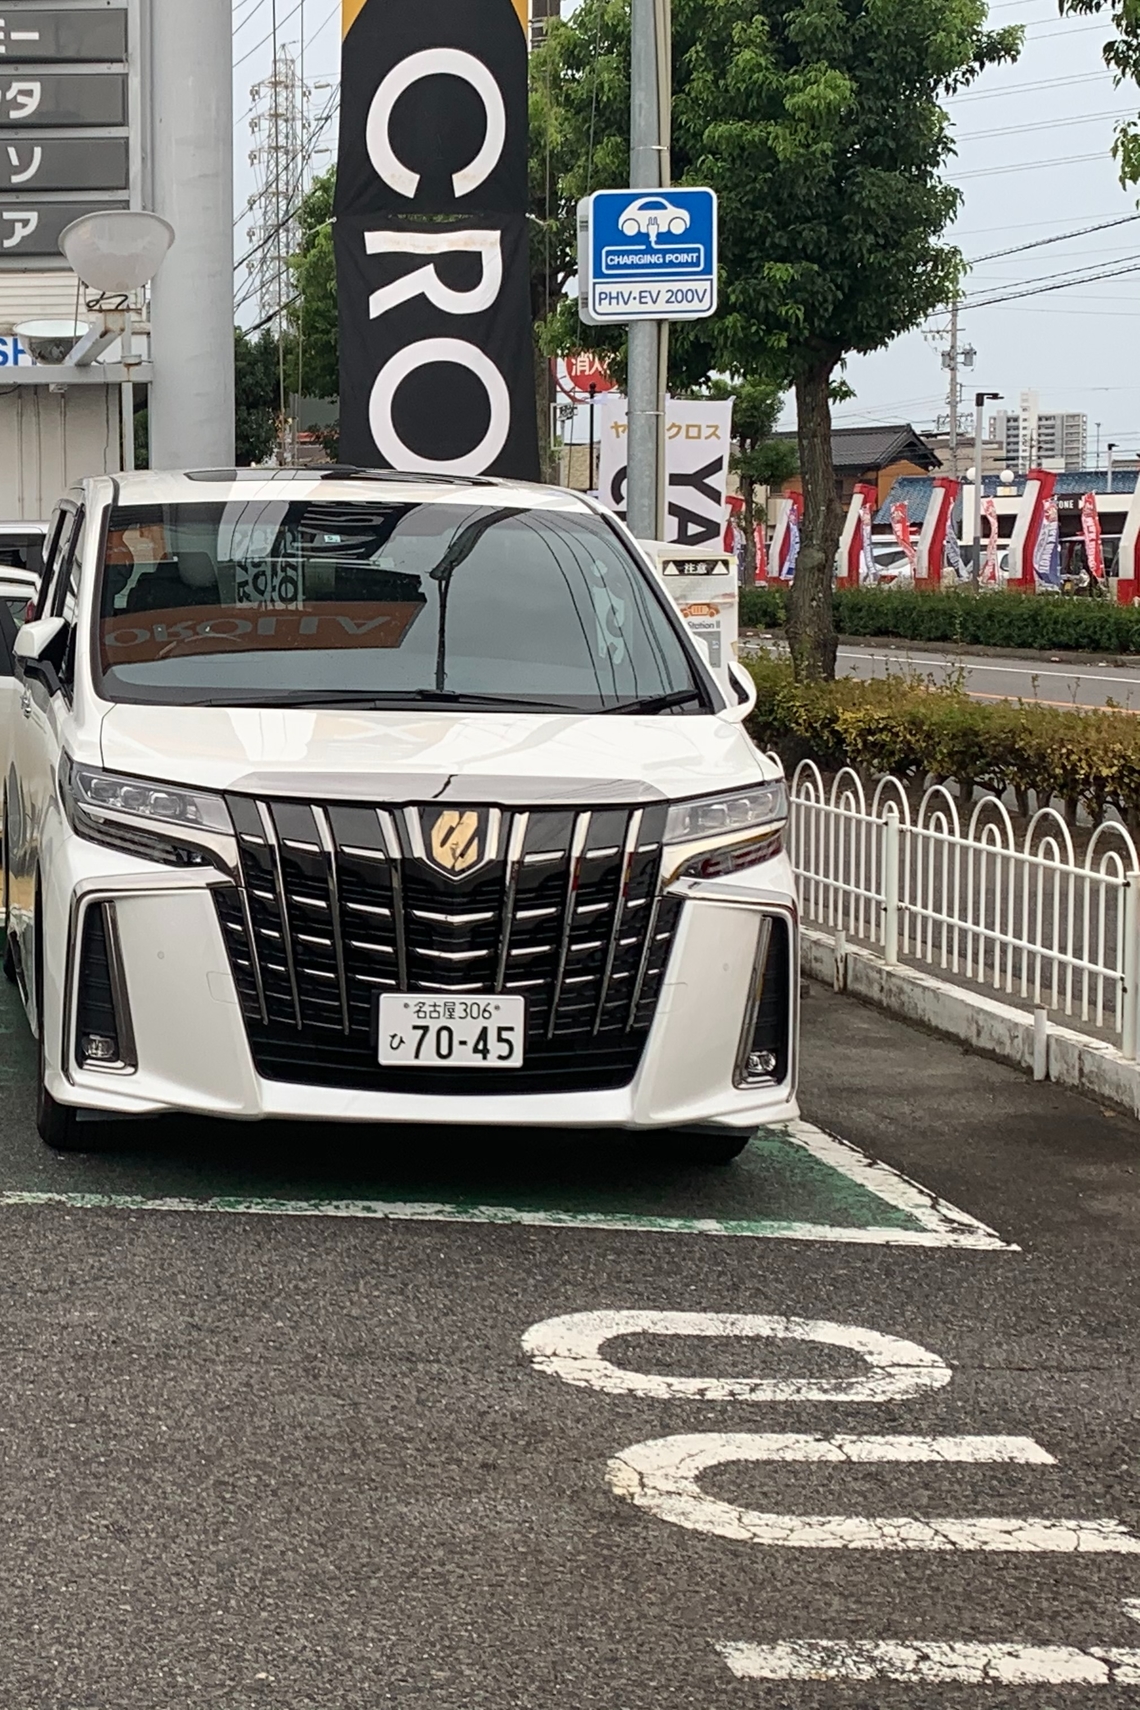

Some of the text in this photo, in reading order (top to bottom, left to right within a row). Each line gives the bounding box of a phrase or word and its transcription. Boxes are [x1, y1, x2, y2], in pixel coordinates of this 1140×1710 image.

[607, 253, 699, 265] CHARGING POINT
[665, 288, 708, 304] 200V
[684, 562, 707, 574] 注意
[687, 620, 715, 630] Station
[389, 1024, 515, 1061] ひ 70-45
